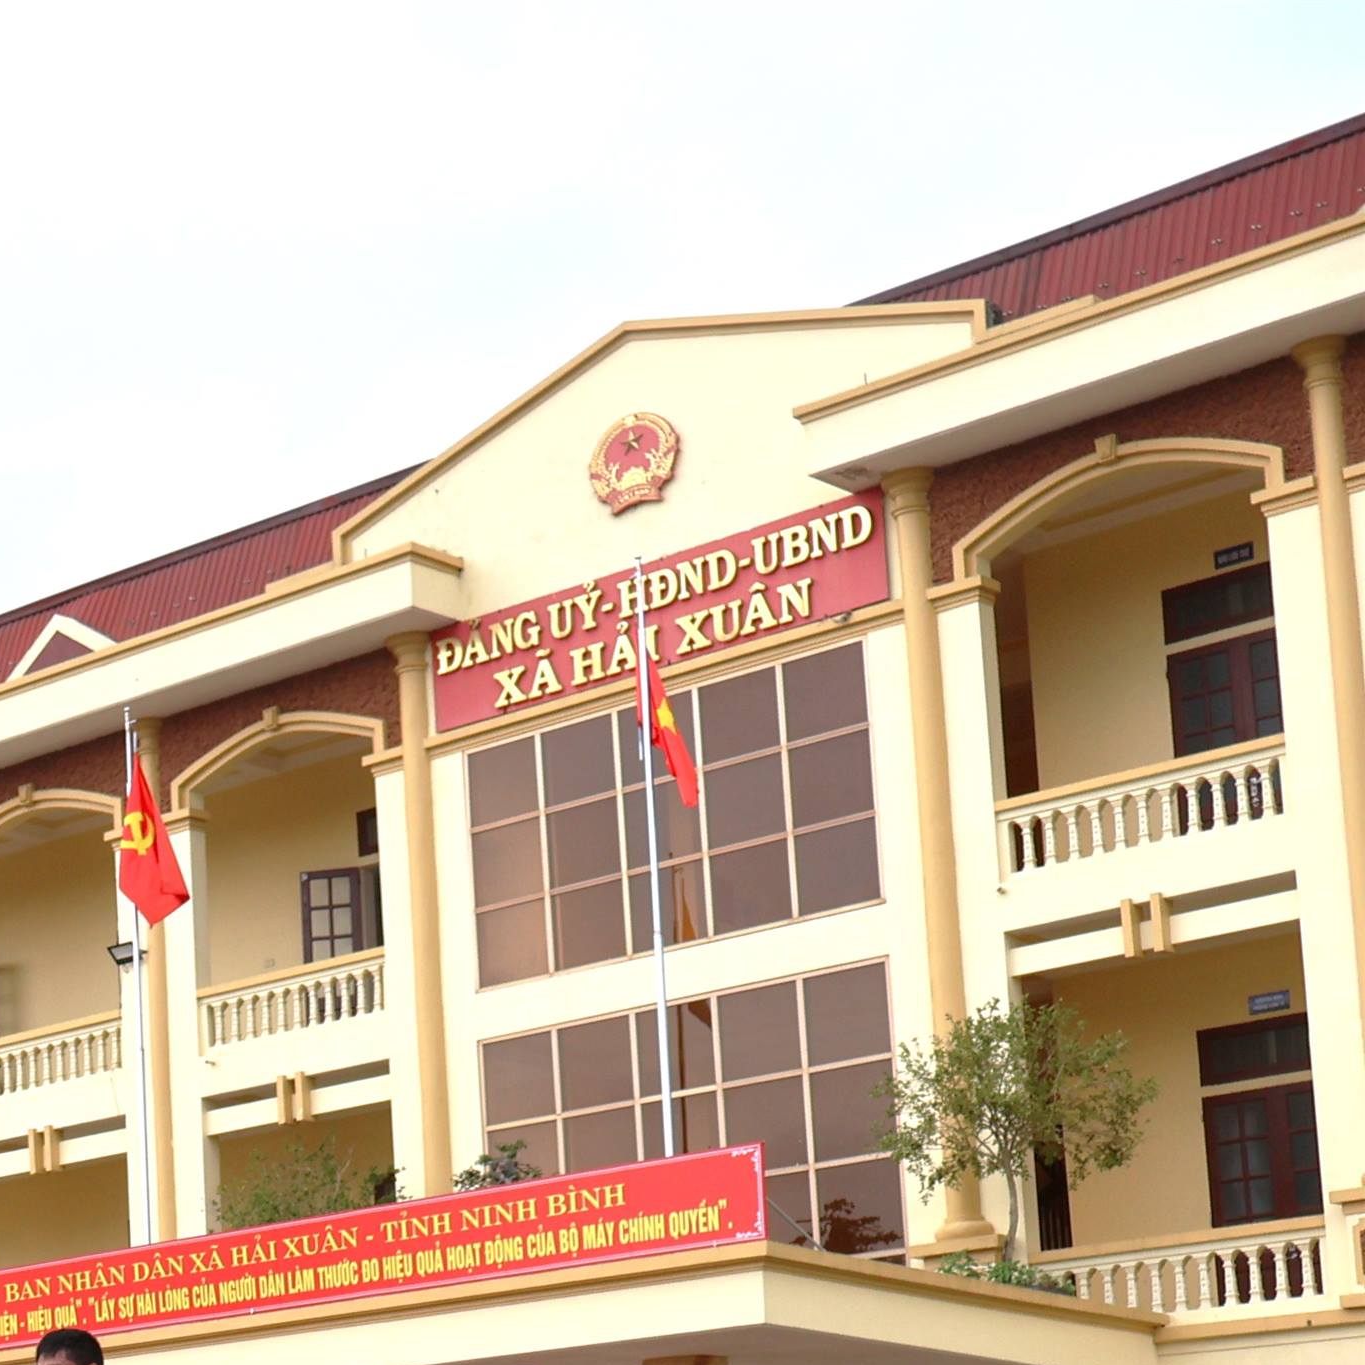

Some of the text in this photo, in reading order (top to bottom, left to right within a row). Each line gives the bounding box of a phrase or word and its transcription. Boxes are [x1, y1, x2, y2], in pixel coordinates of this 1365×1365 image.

[436, 617, 542, 676] ĐẢNG
[492, 577, 813, 709] XÃ HẢI XUÂN
[4, 1276, 52, 1304] BAN
[56, 1261, 126, 1295] NHÂN
[131, 1252, 184, 1283] DÂN
[189, 1244, 226, 1274] XÃ
[230, 1233, 278, 1267] HẢI
[282, 1225, 359, 1260] XUÂN
[379, 1210, 453, 1244] TỈNH
[459, 1197, 538, 1232] NINH
[545, 1183, 626, 1218] BÌNH
[26, 1304, 52, 1336] HIỆU
[118, 1293, 135, 1323] SỰ
[136, 1287, 157, 1317] HÀI
[158, 1283, 190, 1313] LÒNG
[191, 1276, 217, 1308] CỦA
[218, 1271, 257, 1305] NGƯỜI
[259, 1268, 285, 1299] DÂN
[287, 1264, 315, 1295] LÀM
[317, 1257, 359, 1291] THƯỚC
[361, 1257, 380, 1284] ĐO
[382, 1248, 413, 1284] HIỆU
[415, 1240, 444, 1278] QUẢ
[446, 1241, 482, 1274] HOẠT
[484, 1233, 524, 1270] ĐỘNG
[526, 1223, 557, 1259] CỦA
[558, 1221, 580, 1258] BỘ
[582, 1217, 615, 1250] MÁY
[618, 1210, 666, 1245] CHÍNH
